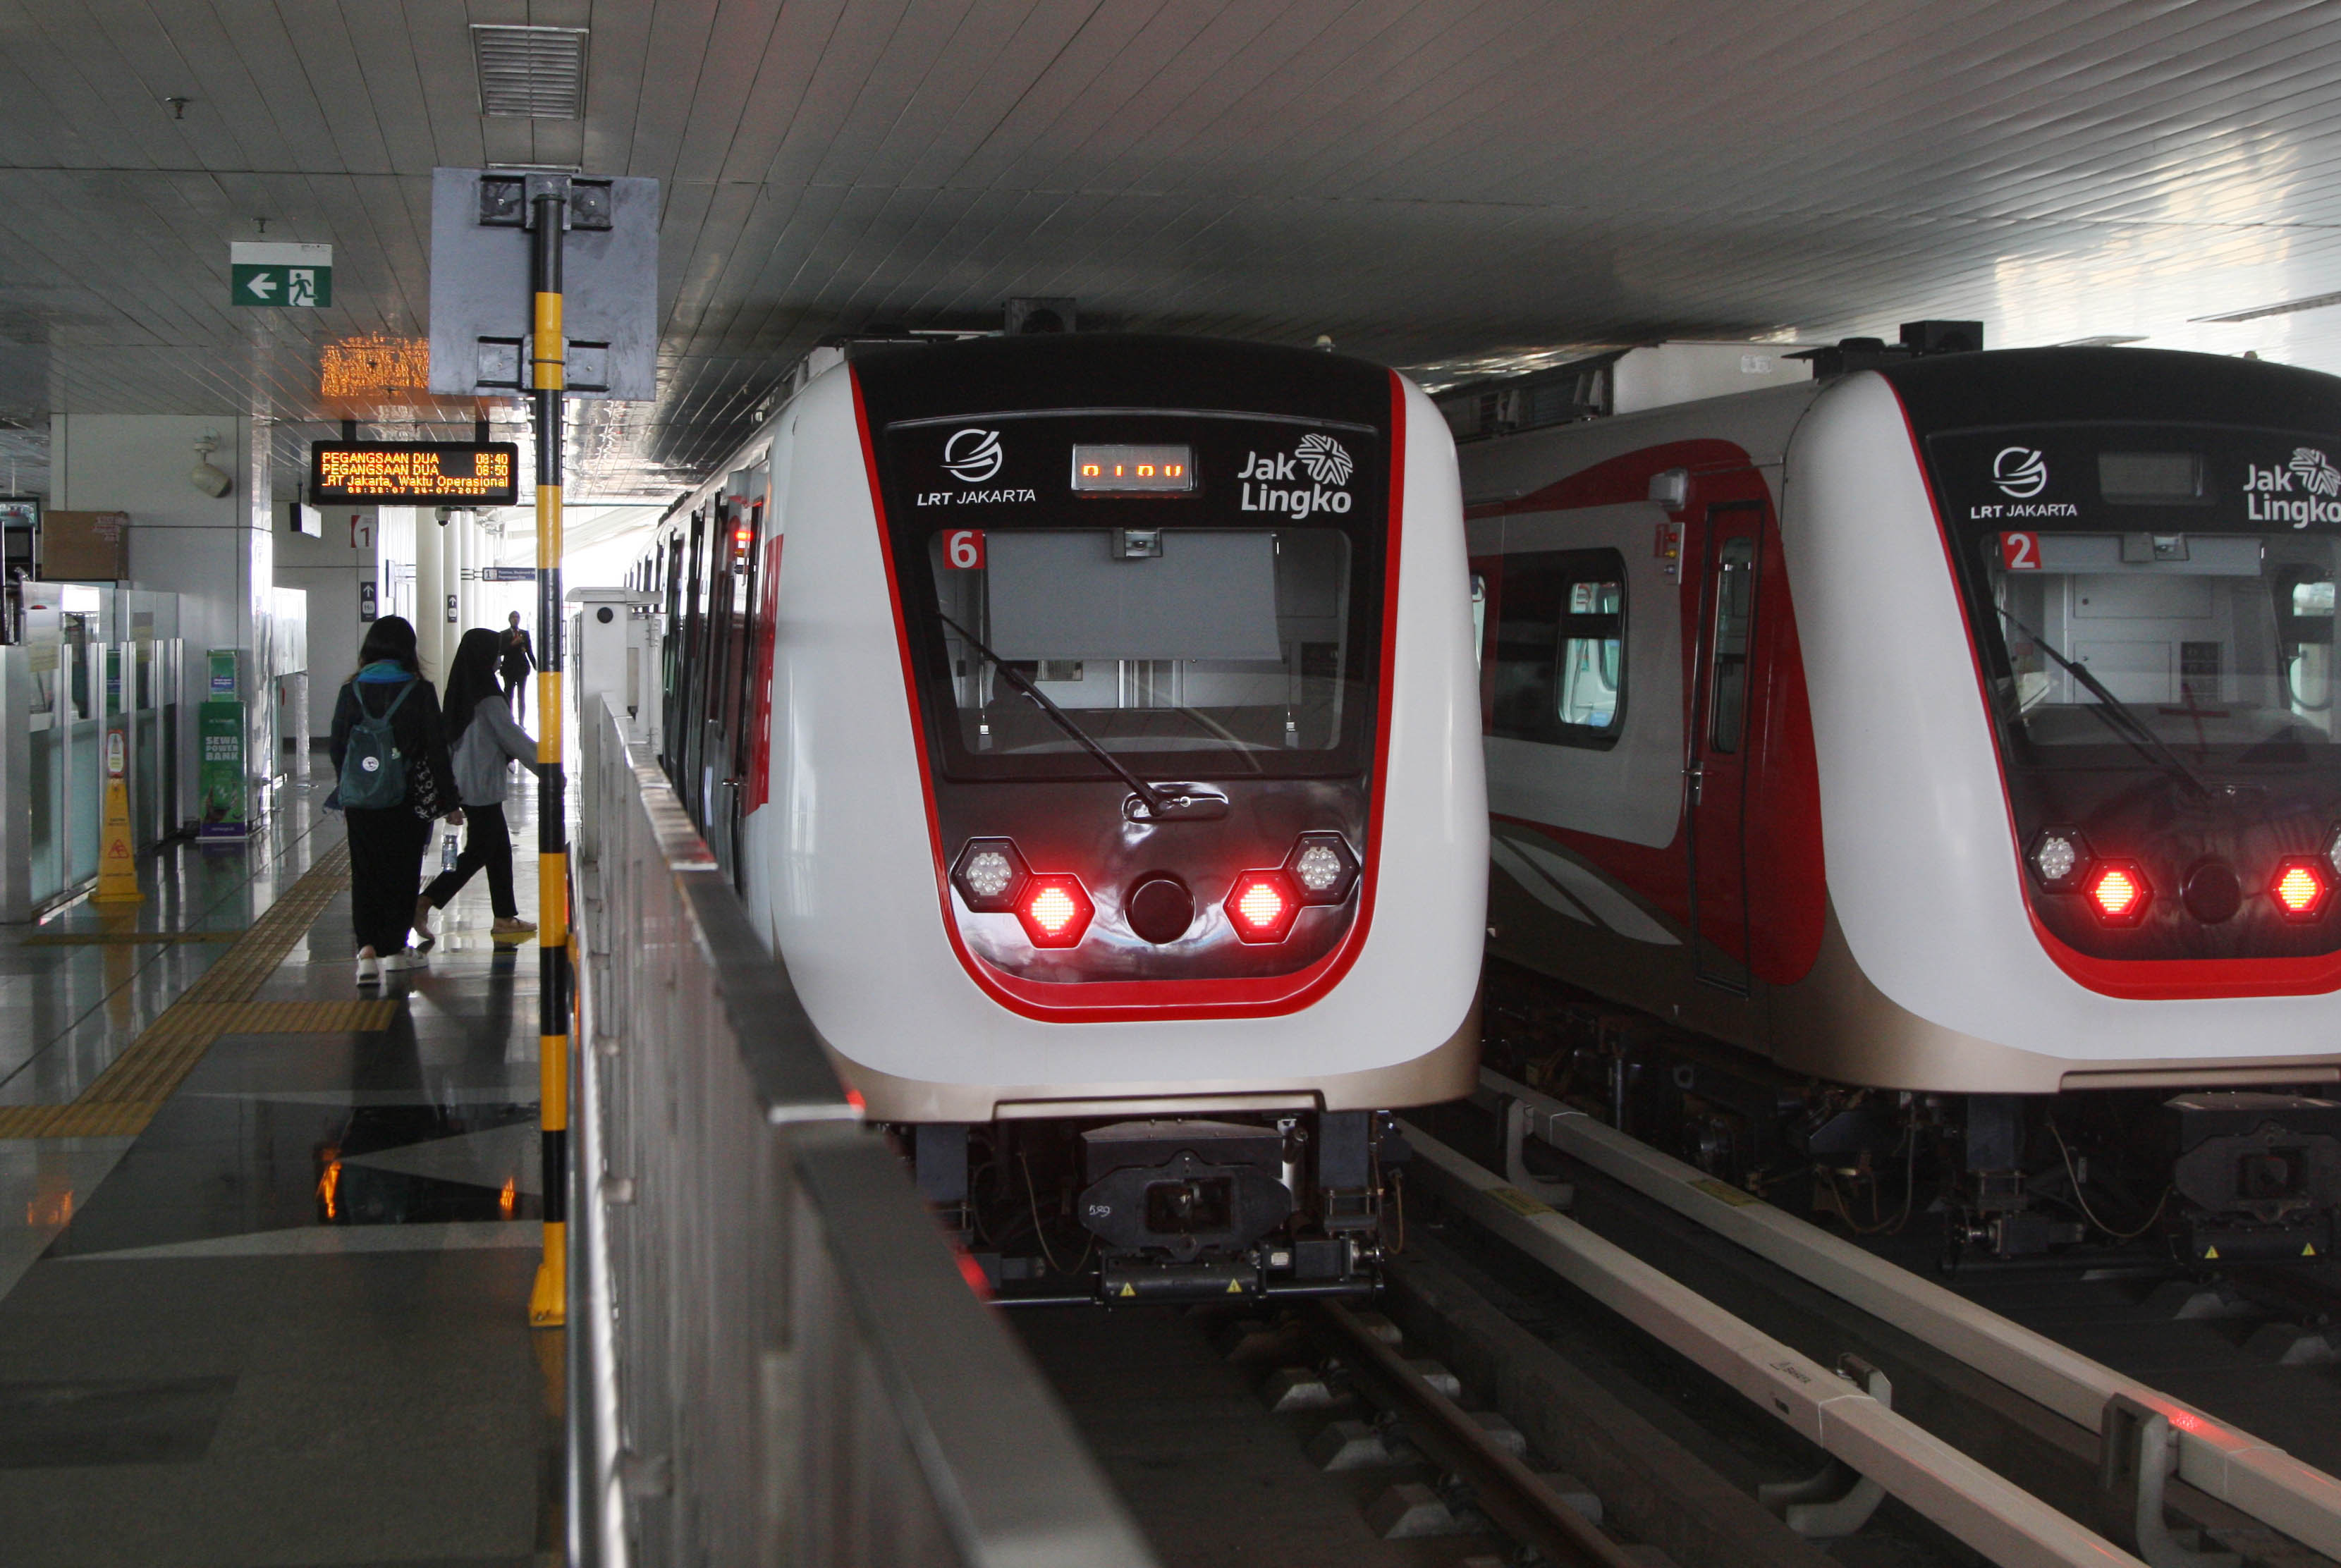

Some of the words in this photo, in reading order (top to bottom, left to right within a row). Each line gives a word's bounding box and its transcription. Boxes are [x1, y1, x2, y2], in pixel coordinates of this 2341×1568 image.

[322, 452, 409, 464] PEGANGSAAN
[412, 452, 439, 464] DUA
[1237, 451, 1297, 480] Jak
[322, 464, 409, 475] PEGANGSAAN
[412, 464, 439, 475] DUA
[475, 465, 508, 476] 08:50
[2242, 463, 2292, 491] Jak
[398, 475, 434, 486] Waktu
[436, 475, 508, 487] Operasional
[917, 493, 953, 506] LRT
[956, 489, 1037, 505] JAKARTA
[1241, 482, 1352, 520] Lingko
[1970, 505, 2003, 520] LRT
[2006, 503, 2078, 517] JAKARTA
[2248, 493, 2341, 529] Lingko
[360, 526, 369, 547] 1
[950, 531, 977, 568] 6
[2007, 534, 2035, 568] 2
[205, 736, 238, 745] SEWA
[205, 752, 238, 761] BANK
